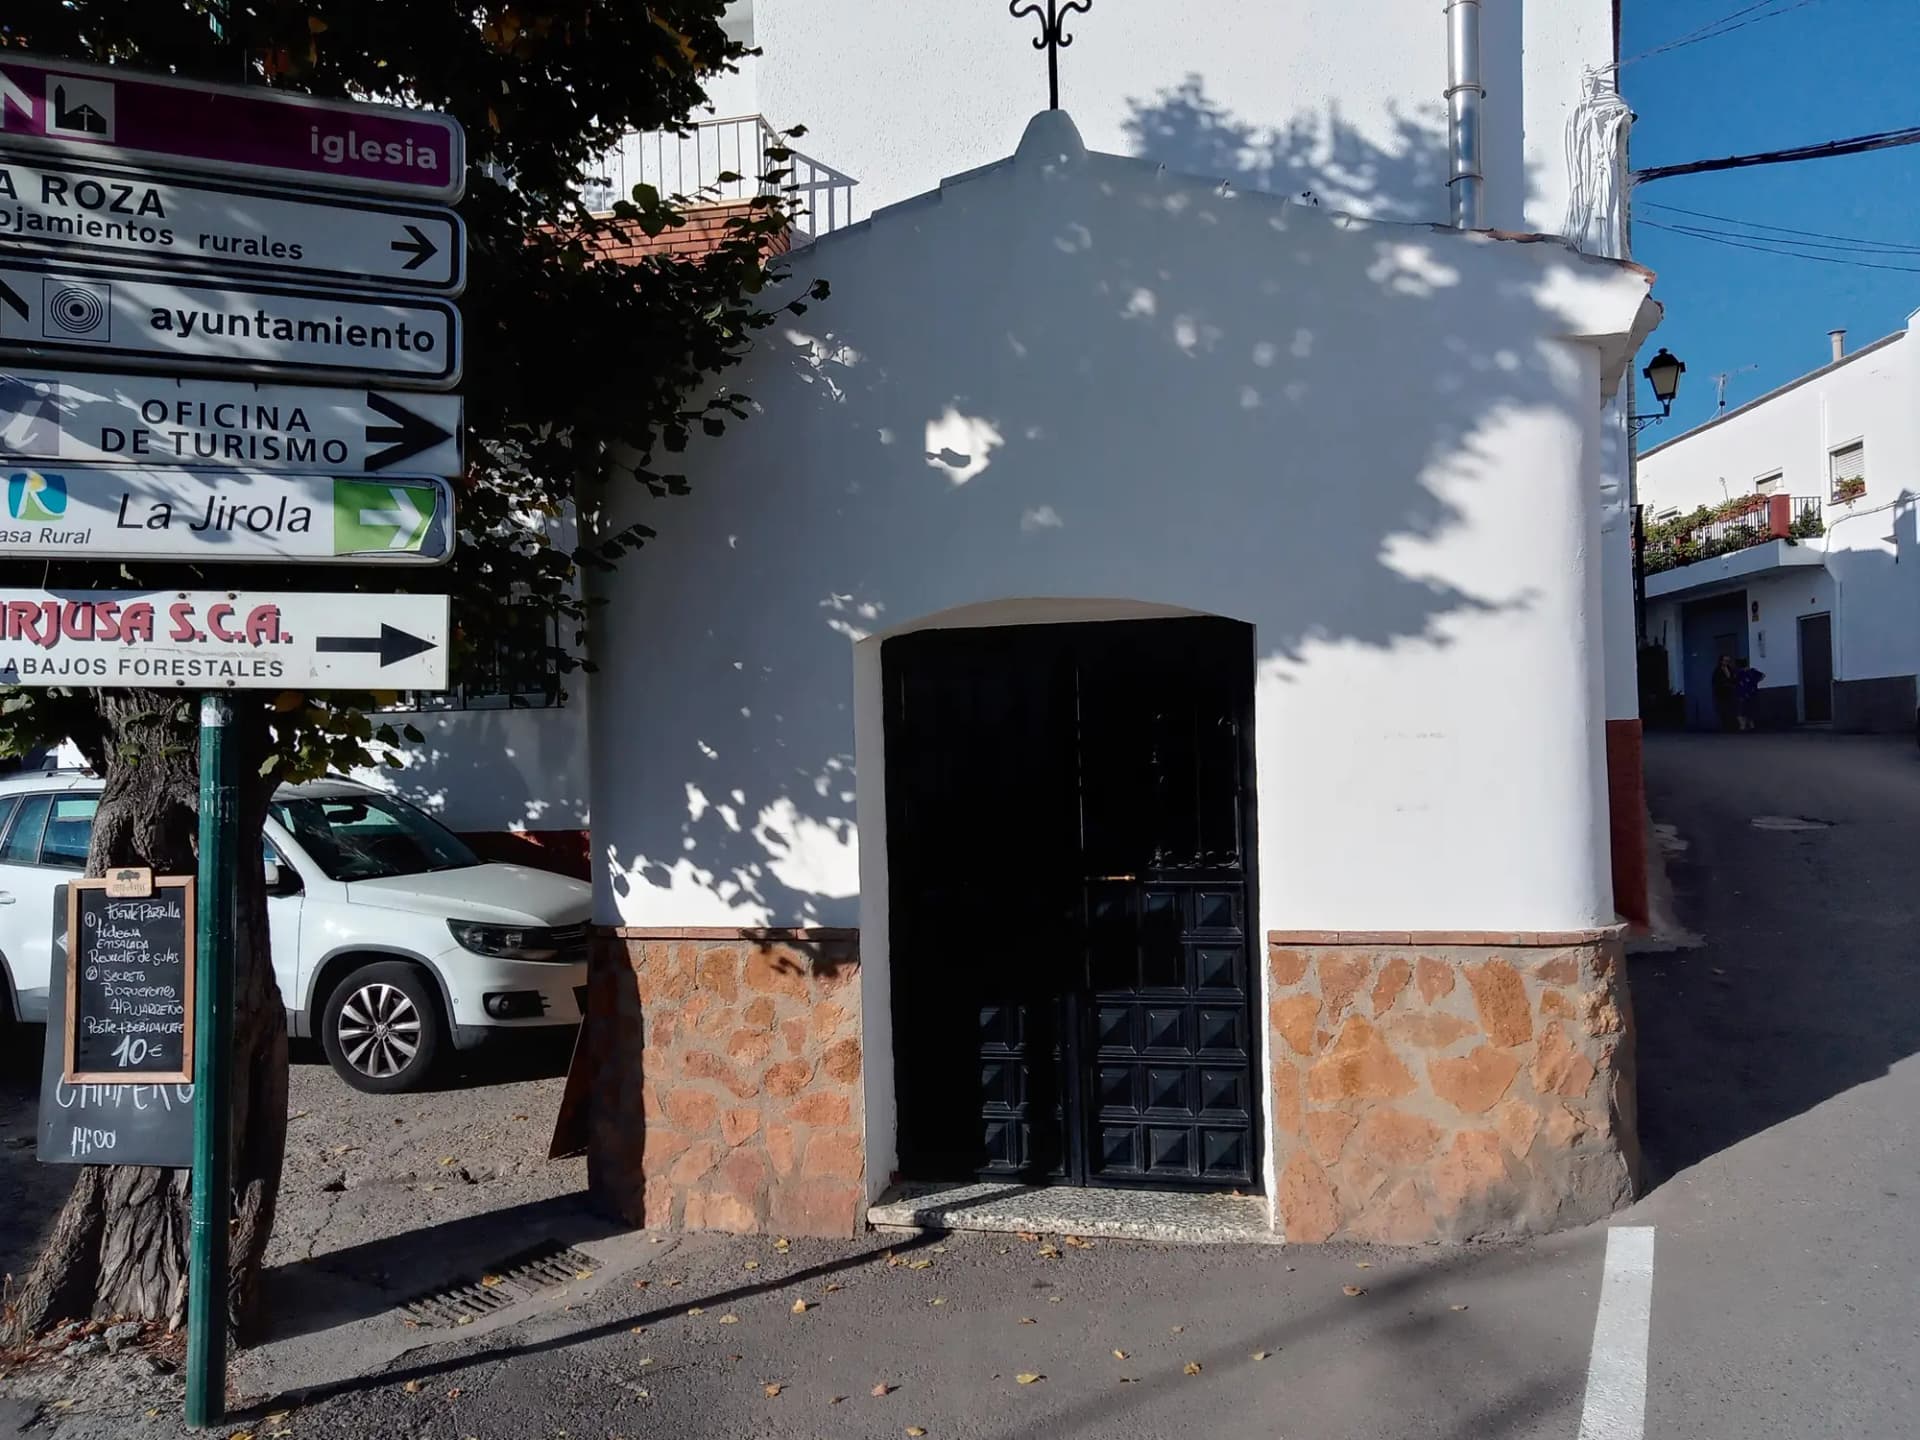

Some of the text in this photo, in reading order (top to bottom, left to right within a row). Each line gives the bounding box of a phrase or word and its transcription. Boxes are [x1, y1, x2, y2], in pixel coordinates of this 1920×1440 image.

[310, 126, 439, 170] iglesia
[41, 174, 166, 218] ROZA
[199, 232, 304, 260] rurales
[150, 306, 435, 352] ayuntamiento
[141, 399, 312, 433] OFICINA
[101, 428, 349, 464] DE TURISMO
[116, 493, 313, 533] La Jirola
[39, 527, 92, 545] Rural
[169, 602, 294, 649] S.C.A.
[119, 658, 284, 677] FORESTALES
[137, 949, 151, 964] de
[71, 1126, 117, 1158] 14:00
